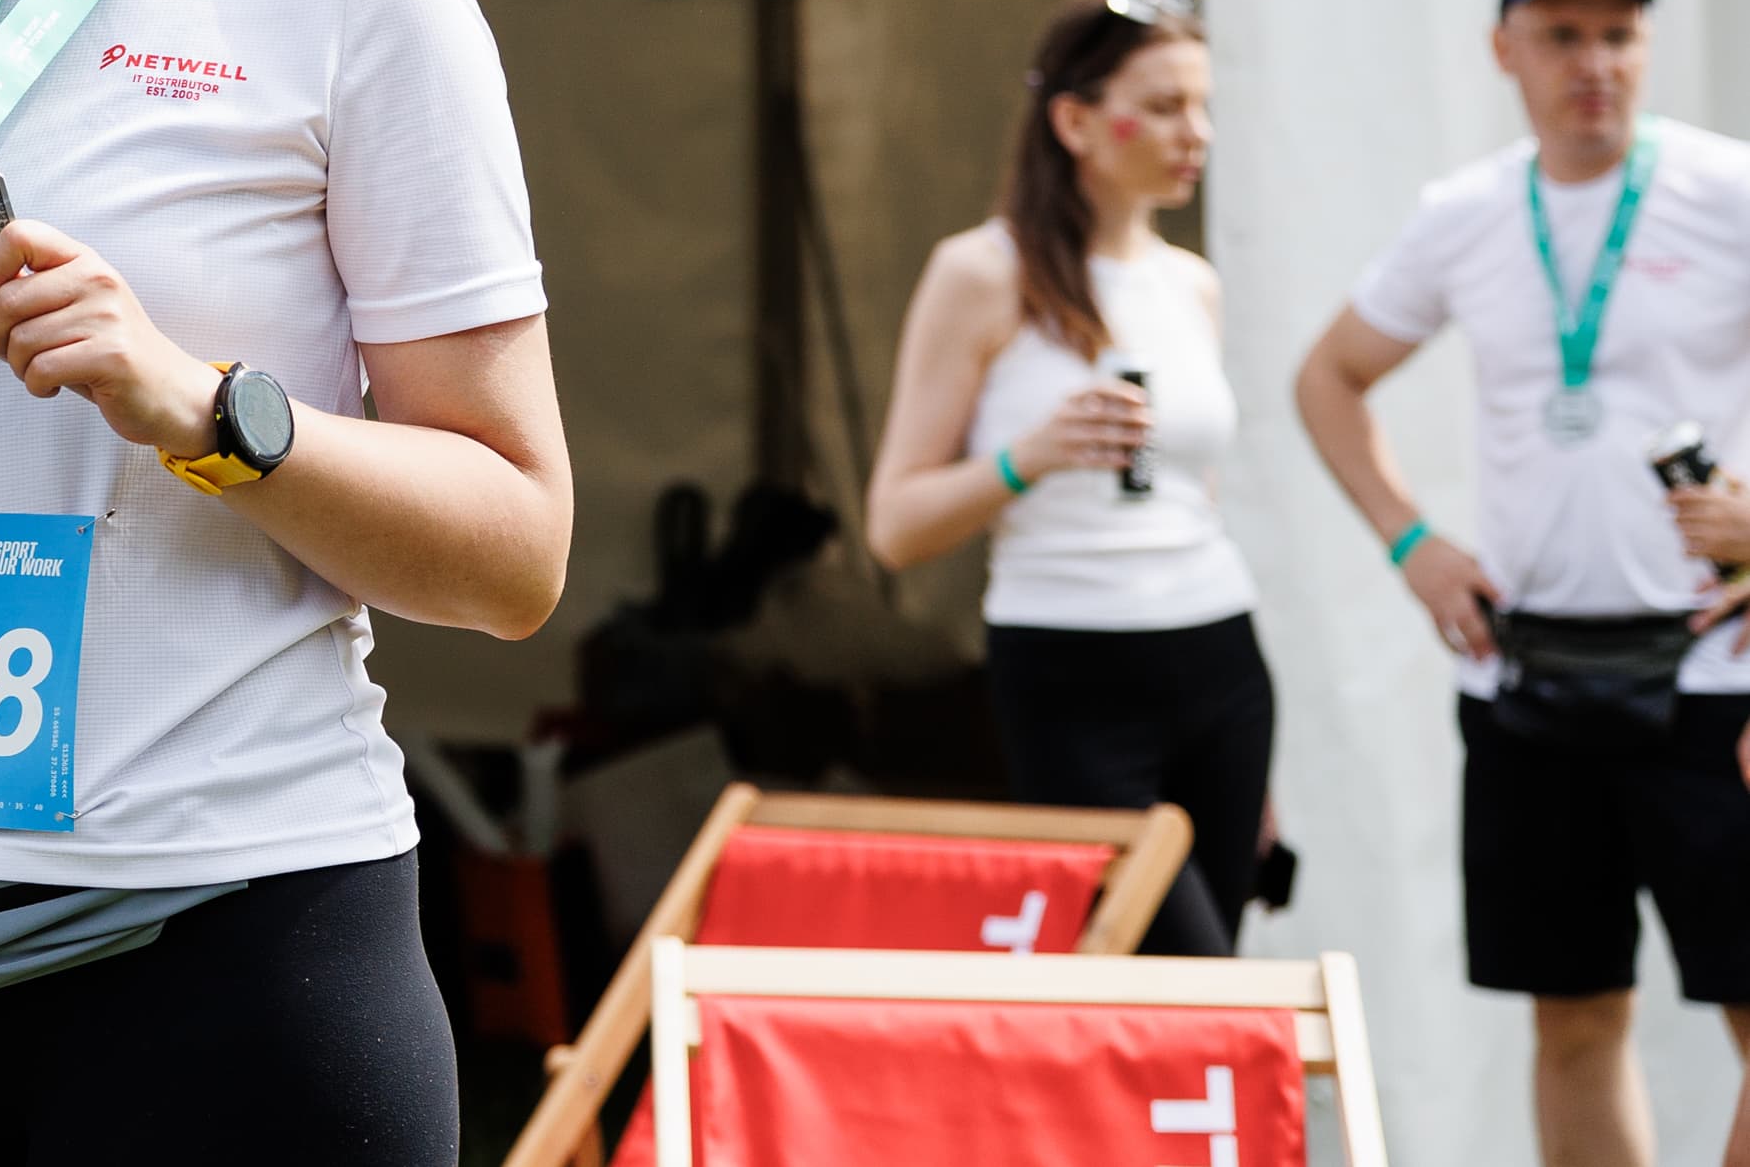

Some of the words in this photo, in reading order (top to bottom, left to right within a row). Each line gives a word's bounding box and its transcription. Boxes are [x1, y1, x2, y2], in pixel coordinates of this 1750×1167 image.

[124, 53, 248, 81] NETWELL
[132, 74, 143, 82] IT
[146, 75, 220, 94] DISTRIBUTOR
[146, 86, 168, 97] EST.
[172, 89, 200, 101] 2003
[20, 558, 64, 577] WORK
